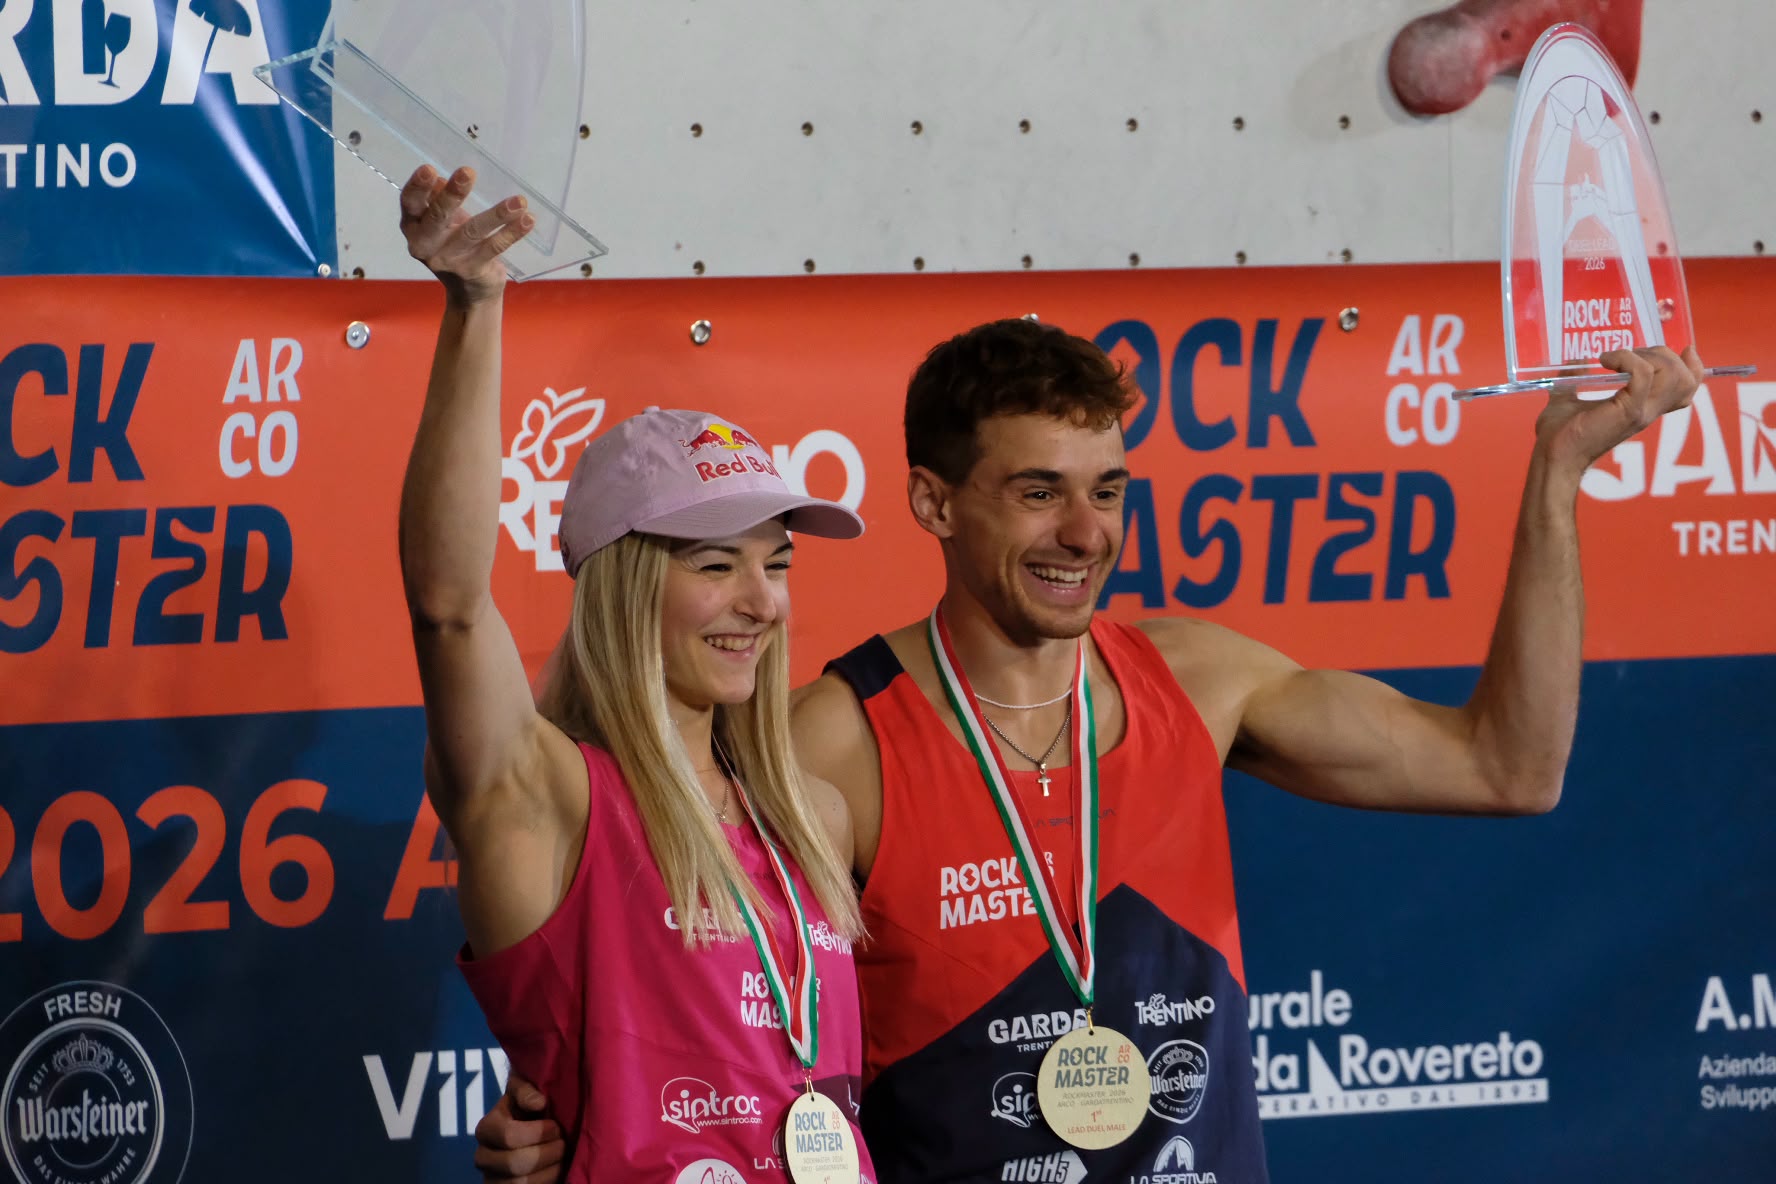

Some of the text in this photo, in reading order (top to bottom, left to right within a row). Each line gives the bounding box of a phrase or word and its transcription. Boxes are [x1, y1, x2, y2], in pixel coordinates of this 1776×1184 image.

[1585, 256, 1606, 271] 2026
[1564, 298, 1631, 329] ROCK AR
[1619, 311, 1632, 325] CO
[222, 338, 303, 404] AR
[1093, 313, 1464, 453] OCK AR
[1384, 382, 1461, 447] CO
[219, 410, 299, 479] CO
[694, 452, 749, 483] Red
[1093, 470, 1457, 611] ASTER
[1671, 519, 1776, 557] TREN
[940, 856, 1022, 897] ROCK
[940, 886, 1038, 930] MASTE
[43, 990, 122, 1021] FRESH
[1134, 993, 1216, 1027] TRENTINO
[987, 1008, 1089, 1045] GARDA
[1016, 1039, 1053, 1054] TRENT
[1057, 1043, 1132, 1067] ROCK AR
[1117, 1054, 1131, 1064] CO
[1339, 1031, 1544, 1088] Rovereto
[28, 1062, 49, 1093] SEIT
[1054, 1065, 1130, 1089] MASTER
[1149, 1068, 1207, 1096] Warsteiner
[16, 1087, 149, 1145] Warsteiner
[668, 1089, 762, 1118] sintroc
[695, 1116, 764, 1128] www.sintroc.com
[794, 1111, 827, 1132] ROCK
[1066, 1126, 1086, 1135] LEAD
[1106, 1123, 1127, 1133] MALE
[795, 1132, 844, 1154] MASTER
[33, 1154, 54, 1182] DAS
[753, 1157, 776, 1170] LA
[1001, 1150, 1071, 1184] HIGH5
